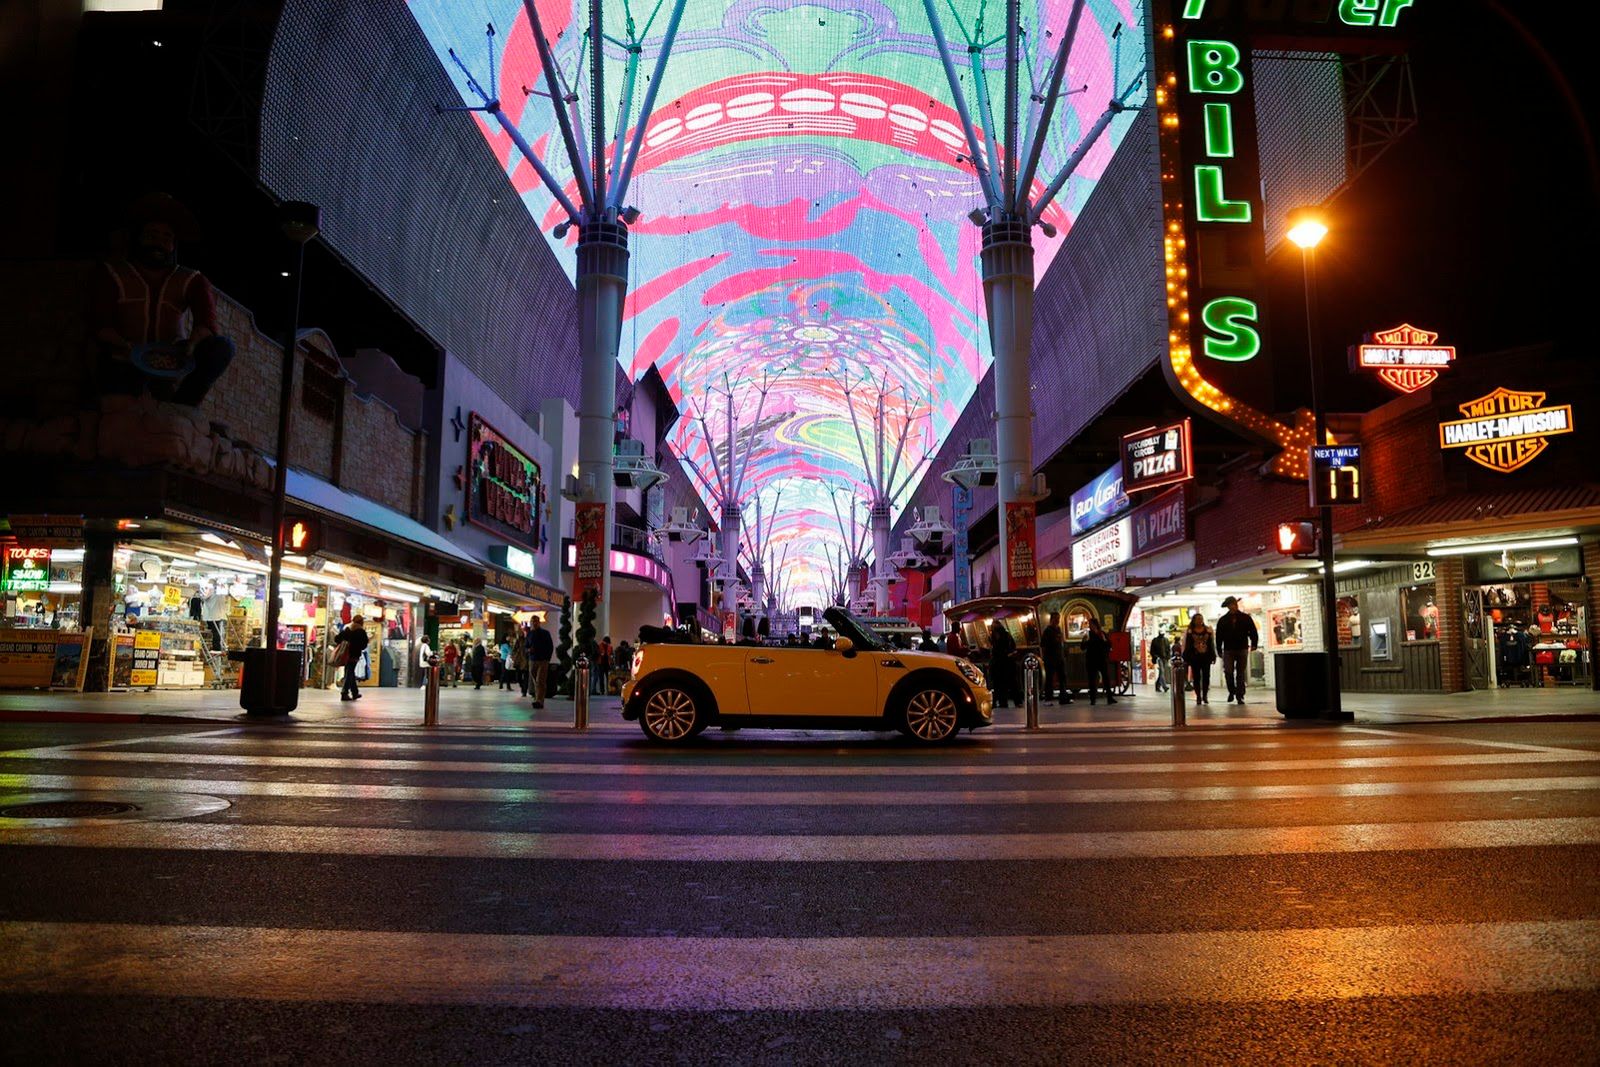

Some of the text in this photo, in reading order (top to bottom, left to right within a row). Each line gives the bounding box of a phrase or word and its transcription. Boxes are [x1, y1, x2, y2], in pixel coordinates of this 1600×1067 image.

[1186, 40, 1262, 362] BILS
[1385, 327, 1429, 344] MOTOR
[1363, 349, 1450, 365] HARLEY-DAVIDSON
[1387, 369, 1432, 387] CYCLES
[1470, 393, 1535, 417] MOTOR
[1445, 409, 1566, 444] HARLEY-DAVIDSON
[1127, 435, 1160, 452] PICCADILLY
[1133, 445, 1155, 459] CIRCUS
[1314, 448, 1359, 458] NEXT WALK
[1332, 457, 1341, 466] IN
[1475, 438, 1539, 468] CYCLES
[1133, 451, 1176, 479] PIZZA
[1329, 467, 1359, 499] 17
[1075, 476, 1124, 519] BUD LIGHT
[1149, 502, 1180, 539] PIZZA
[1081, 524, 1120, 551] SOUVENIRS
[9, 548, 48, 558] TOURS
[1094, 538, 1121, 559] SHIRTS
[23, 559, 36, 569] &
[1085, 554, 1118, 573] ALCOHOL
[12, 569, 47, 579] SHOW
[7, 580, 48, 590] TICKETS
